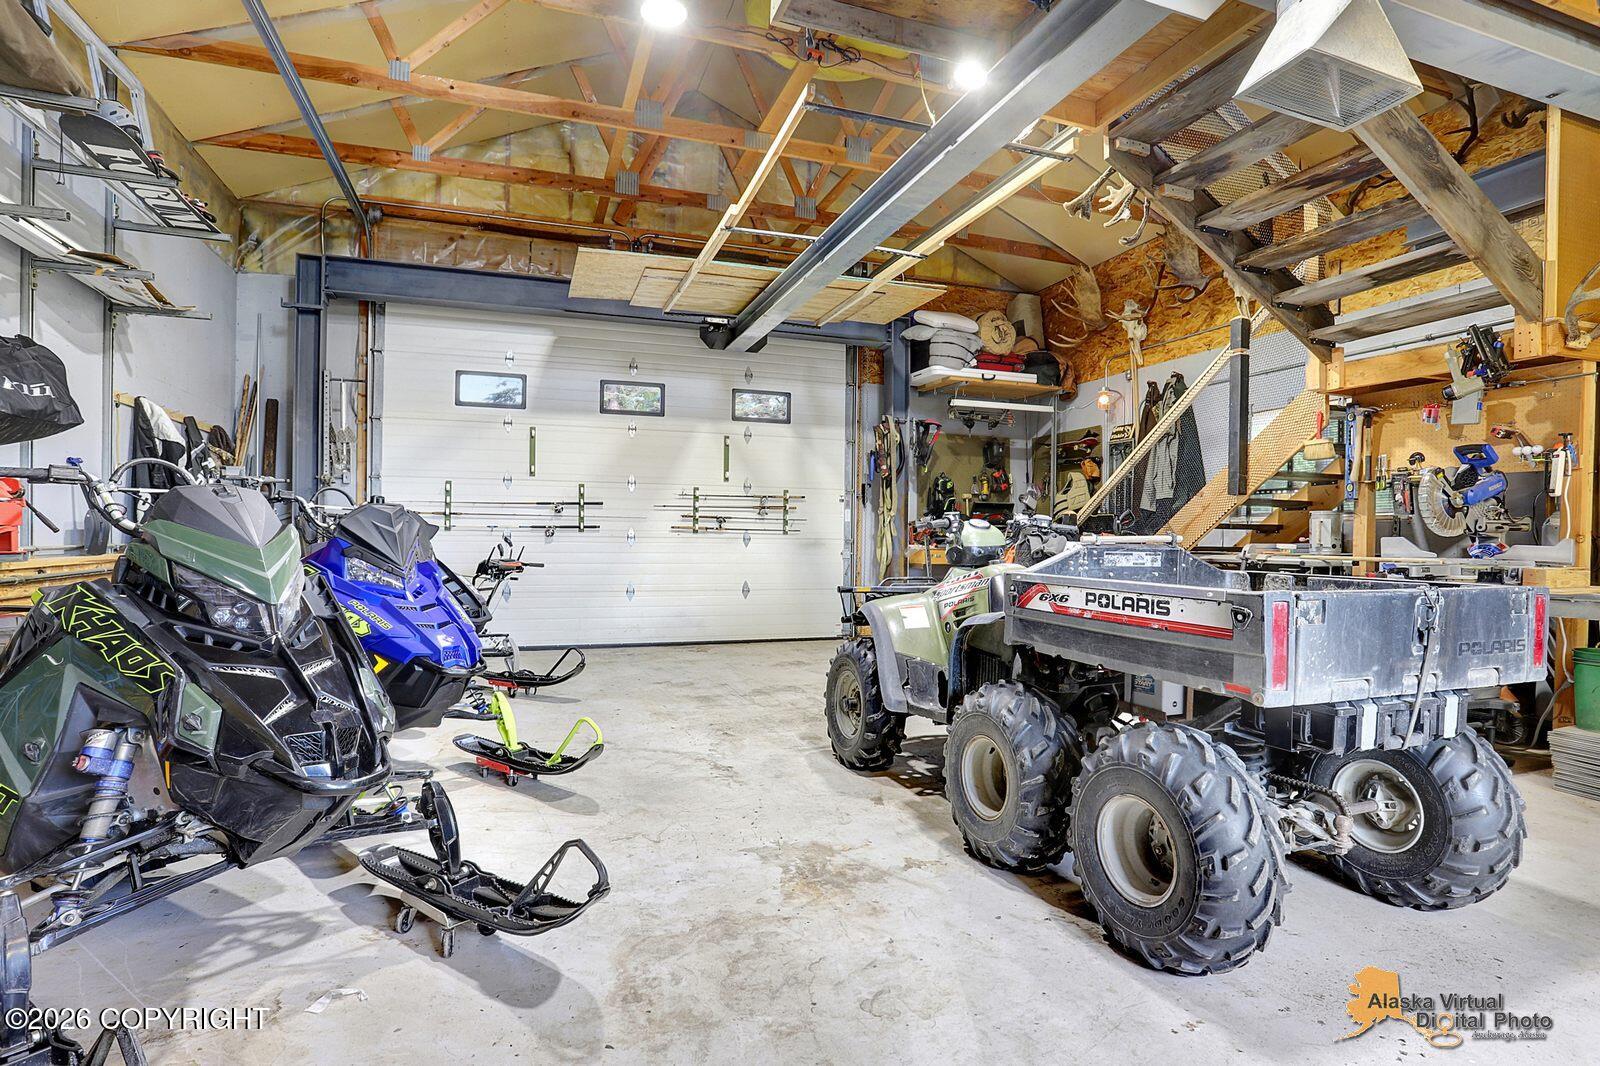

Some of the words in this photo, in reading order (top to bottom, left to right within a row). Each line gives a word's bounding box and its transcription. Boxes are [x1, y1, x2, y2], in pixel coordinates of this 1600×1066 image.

[933, 577, 990, 599] Sportsman
[943, 595, 976, 609] POLARIS
[1085, 592, 1171, 617] POLARIS
[347, 599, 393, 631] POLARIS
[42, 583, 176, 694] KHAOS
[1457, 639, 1526, 656] POLARIS
